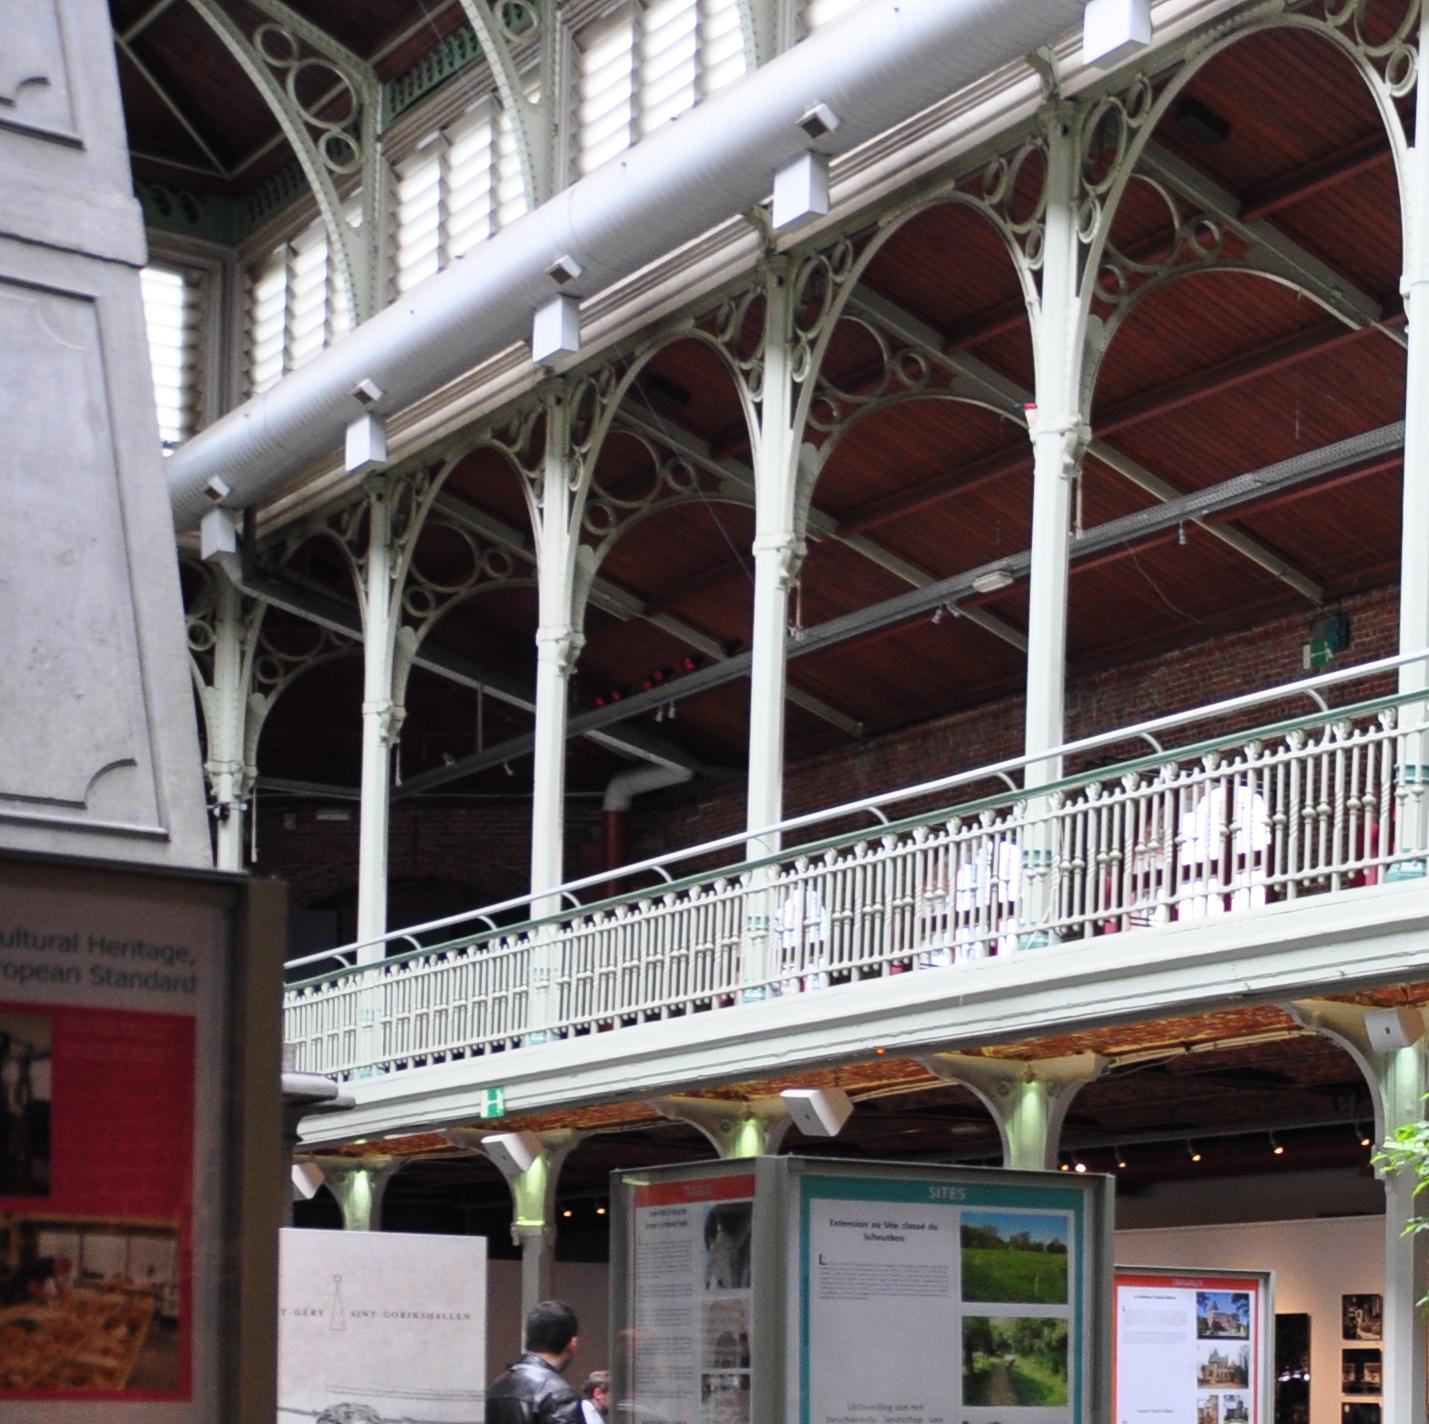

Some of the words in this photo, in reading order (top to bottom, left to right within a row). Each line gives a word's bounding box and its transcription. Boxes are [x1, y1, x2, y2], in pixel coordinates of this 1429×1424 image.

[88, 932, 195, 966] Heritage,
[90, 964, 196, 992] Standard
[928, 1186, 966, 1200] SITES
